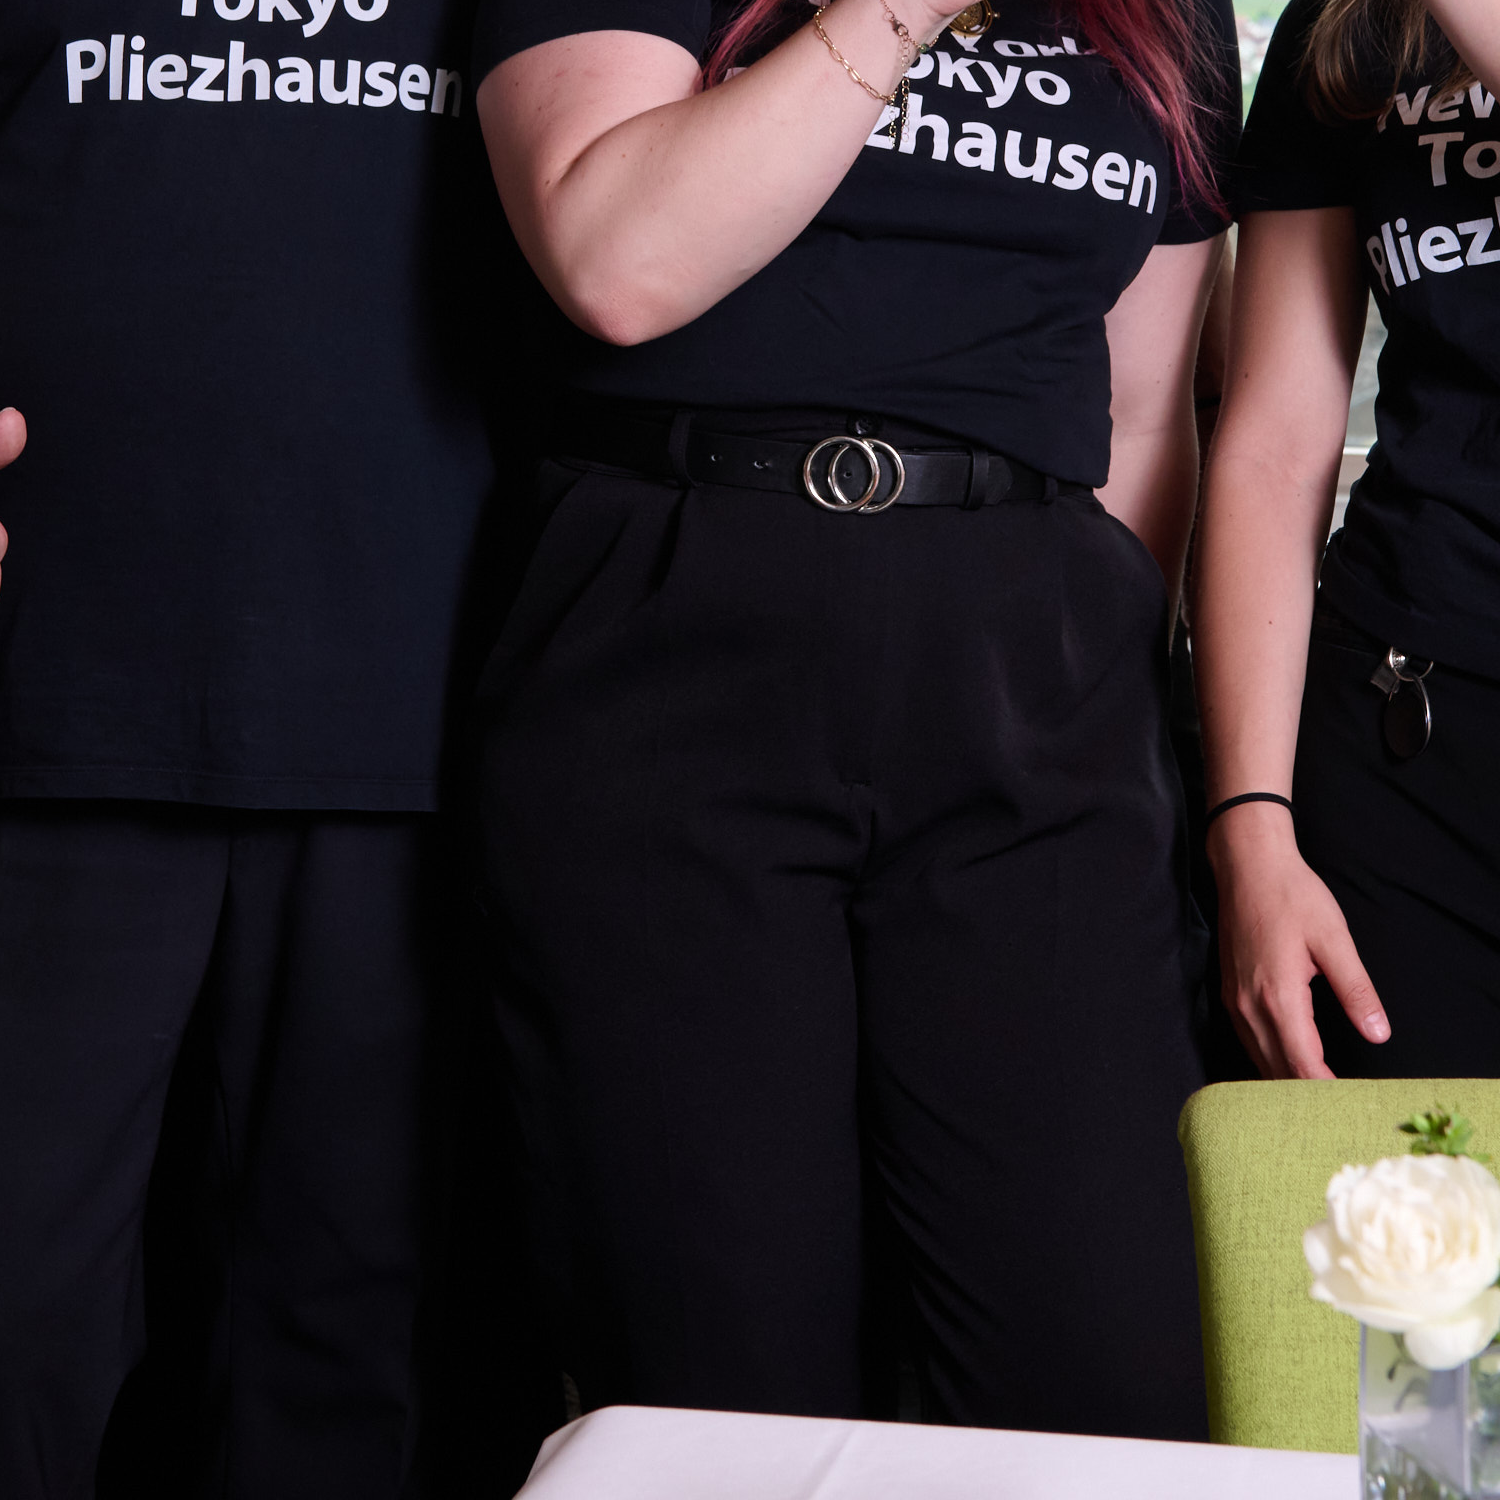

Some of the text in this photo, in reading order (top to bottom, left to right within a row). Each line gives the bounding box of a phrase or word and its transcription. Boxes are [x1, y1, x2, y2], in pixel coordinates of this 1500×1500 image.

[66, 34, 462, 118] Pliezhausen
[903, 51, 1071, 109] okyo
[864, 93, 1157, 214] zhausen
